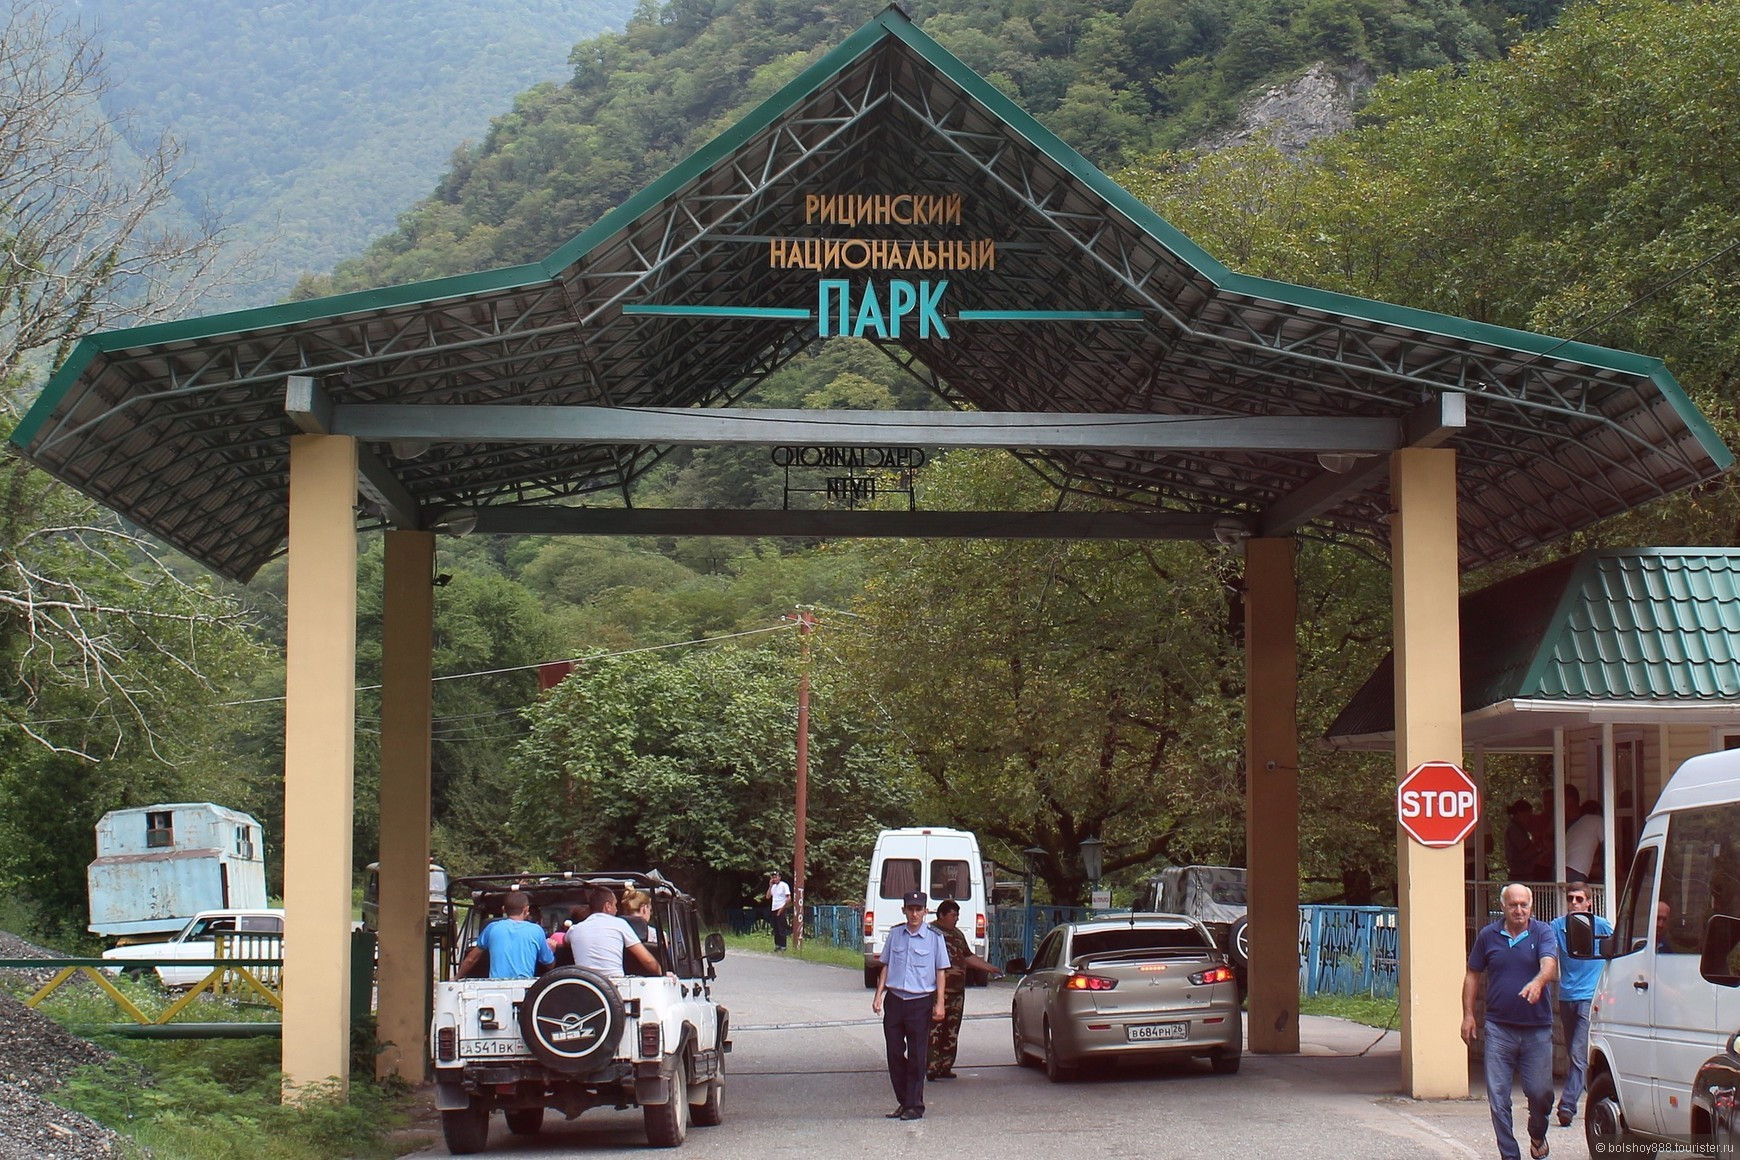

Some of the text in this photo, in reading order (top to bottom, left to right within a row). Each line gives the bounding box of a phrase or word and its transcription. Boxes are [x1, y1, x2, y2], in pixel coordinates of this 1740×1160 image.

[806, 193, 961, 227] РИЦИНСКИЙ
[770, 237, 995, 271] НАЦИОНАЛЬНЫЙ
[818, 277, 950, 339] ПАРК
[1402, 791, 1474, 818] STOP
